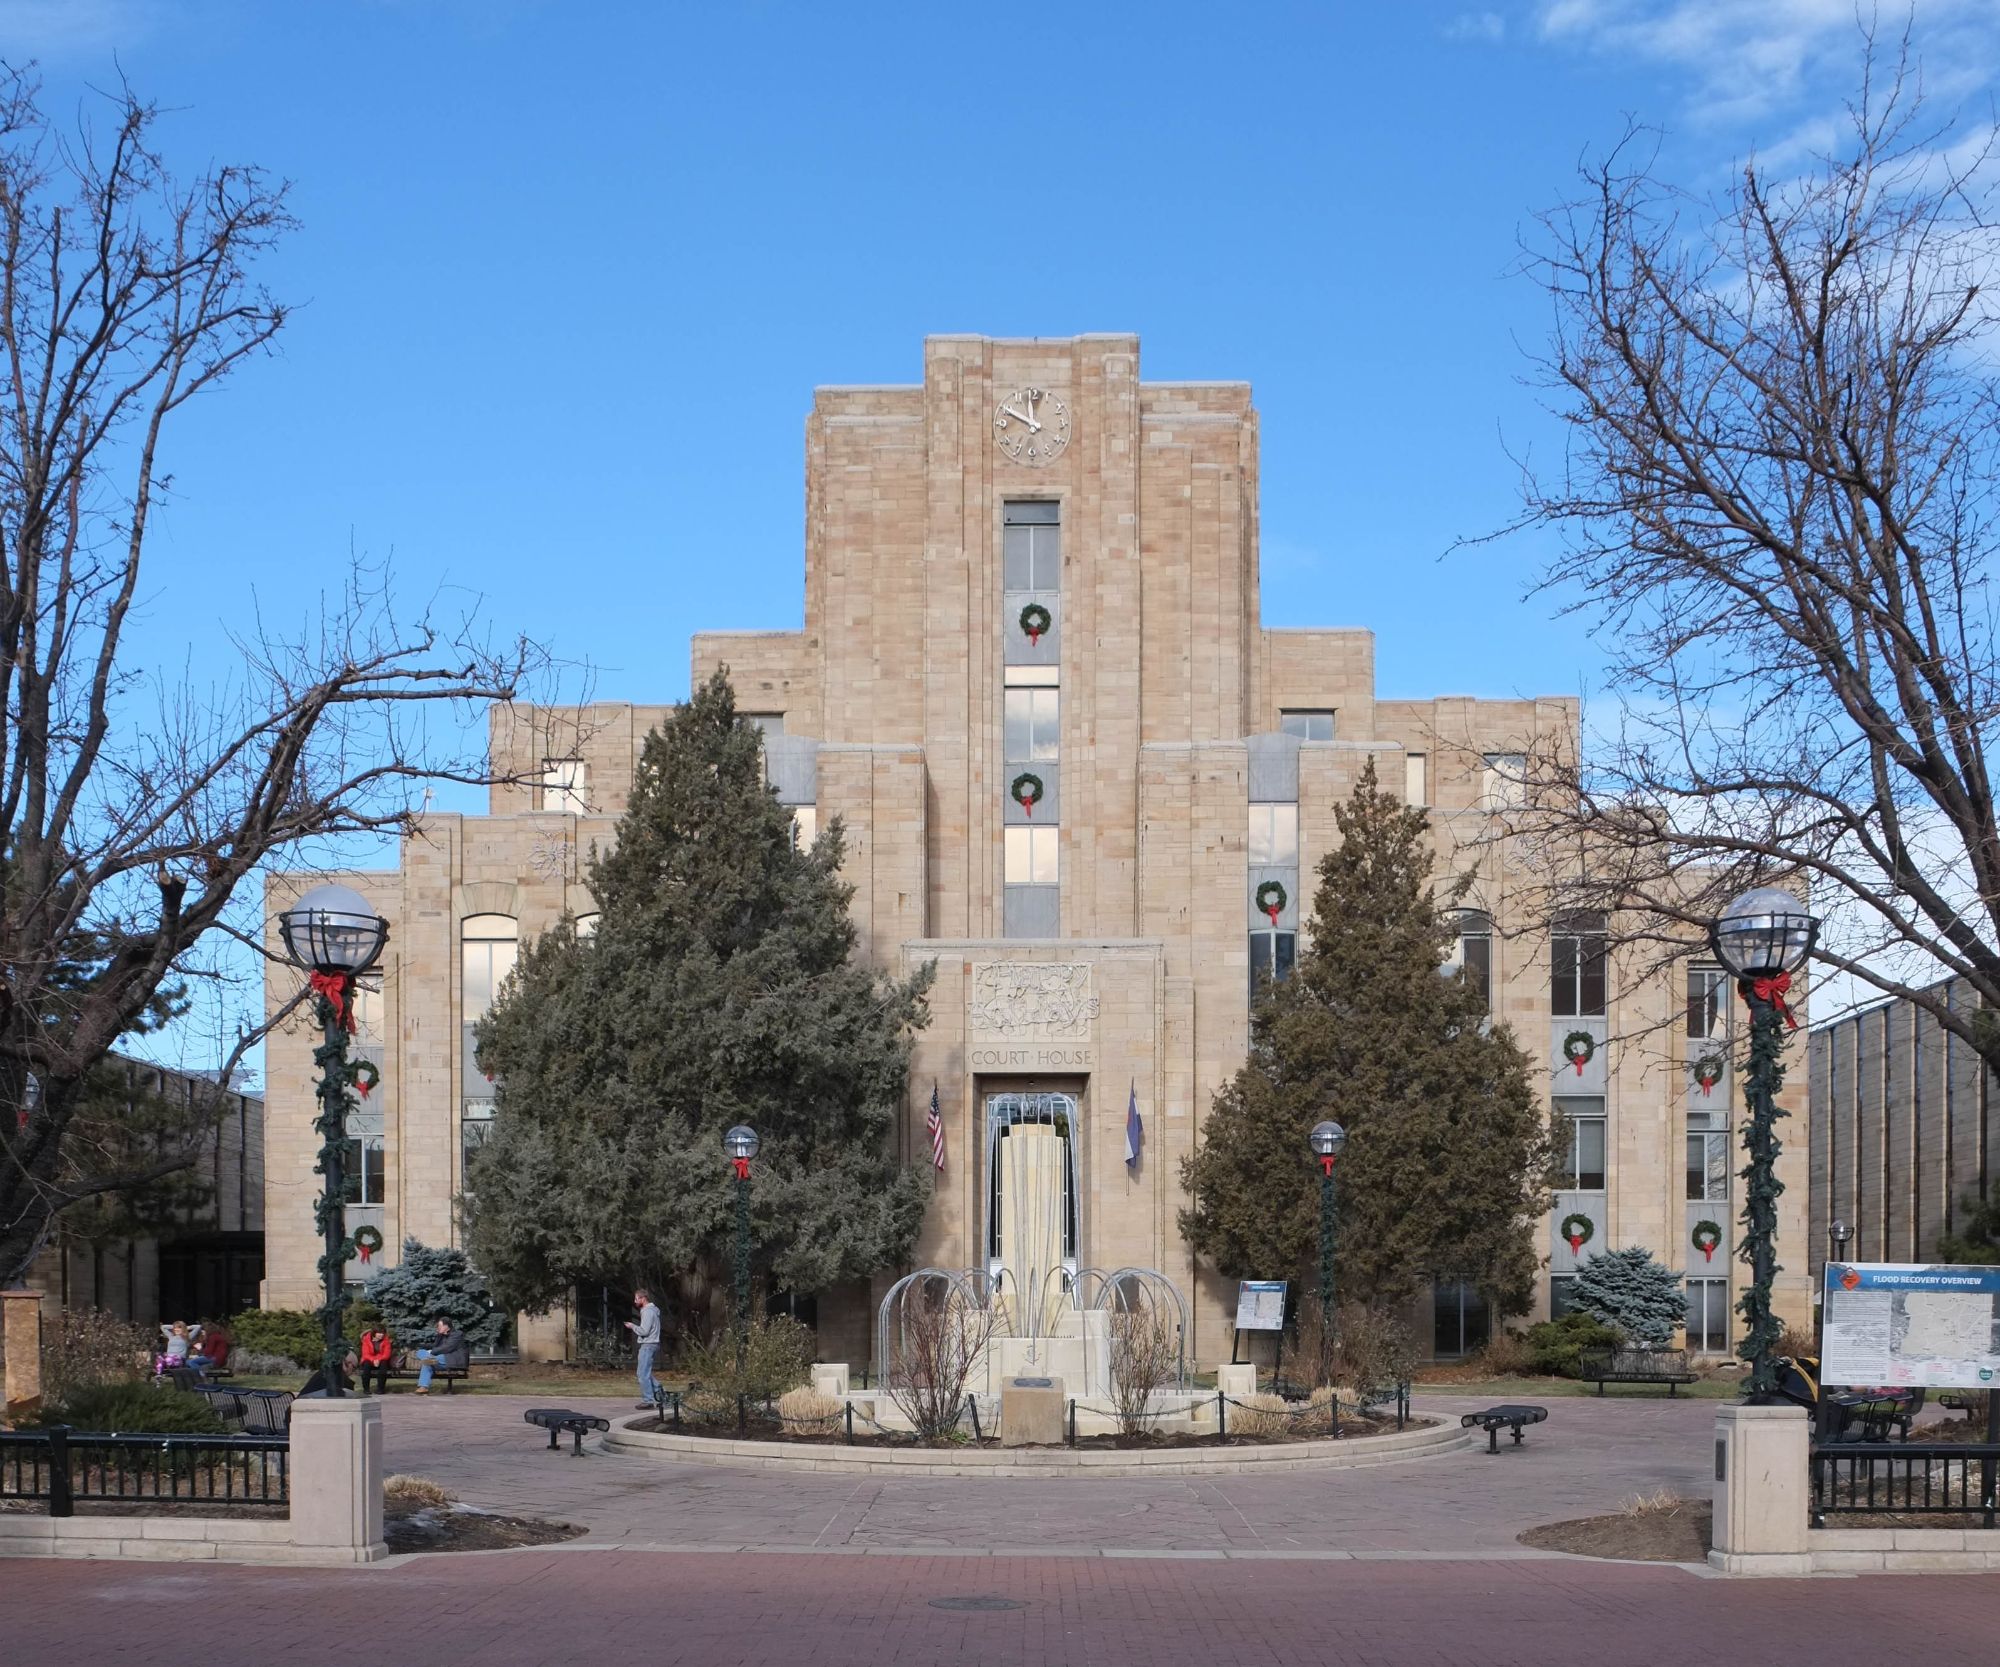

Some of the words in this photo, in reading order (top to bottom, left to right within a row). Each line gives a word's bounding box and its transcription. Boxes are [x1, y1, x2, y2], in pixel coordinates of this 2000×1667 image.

[1015, 392, 1022, 401] 11
[1028, 389, 1038, 400] 12
[1055, 402, 1062, 412] 2
[998, 418, 1007, 428] 9
[1060, 418, 1066, 428] 3
[1004, 434, 1010, 444] 8
[1016, 444, 1022, 454] 7
[1028, 446, 1036, 457] 6
[1044, 444, 1050, 454] 5
[972, 1051, 1029, 1065] COURT
[1038, 1051, 1092, 1065] HOUSE
[1873, 1275, 1899, 1283] FLOOD
[1901, 1276, 1940, 1284] RECOVERY
[1942, 1277, 1983, 1285] OVERVIEW
